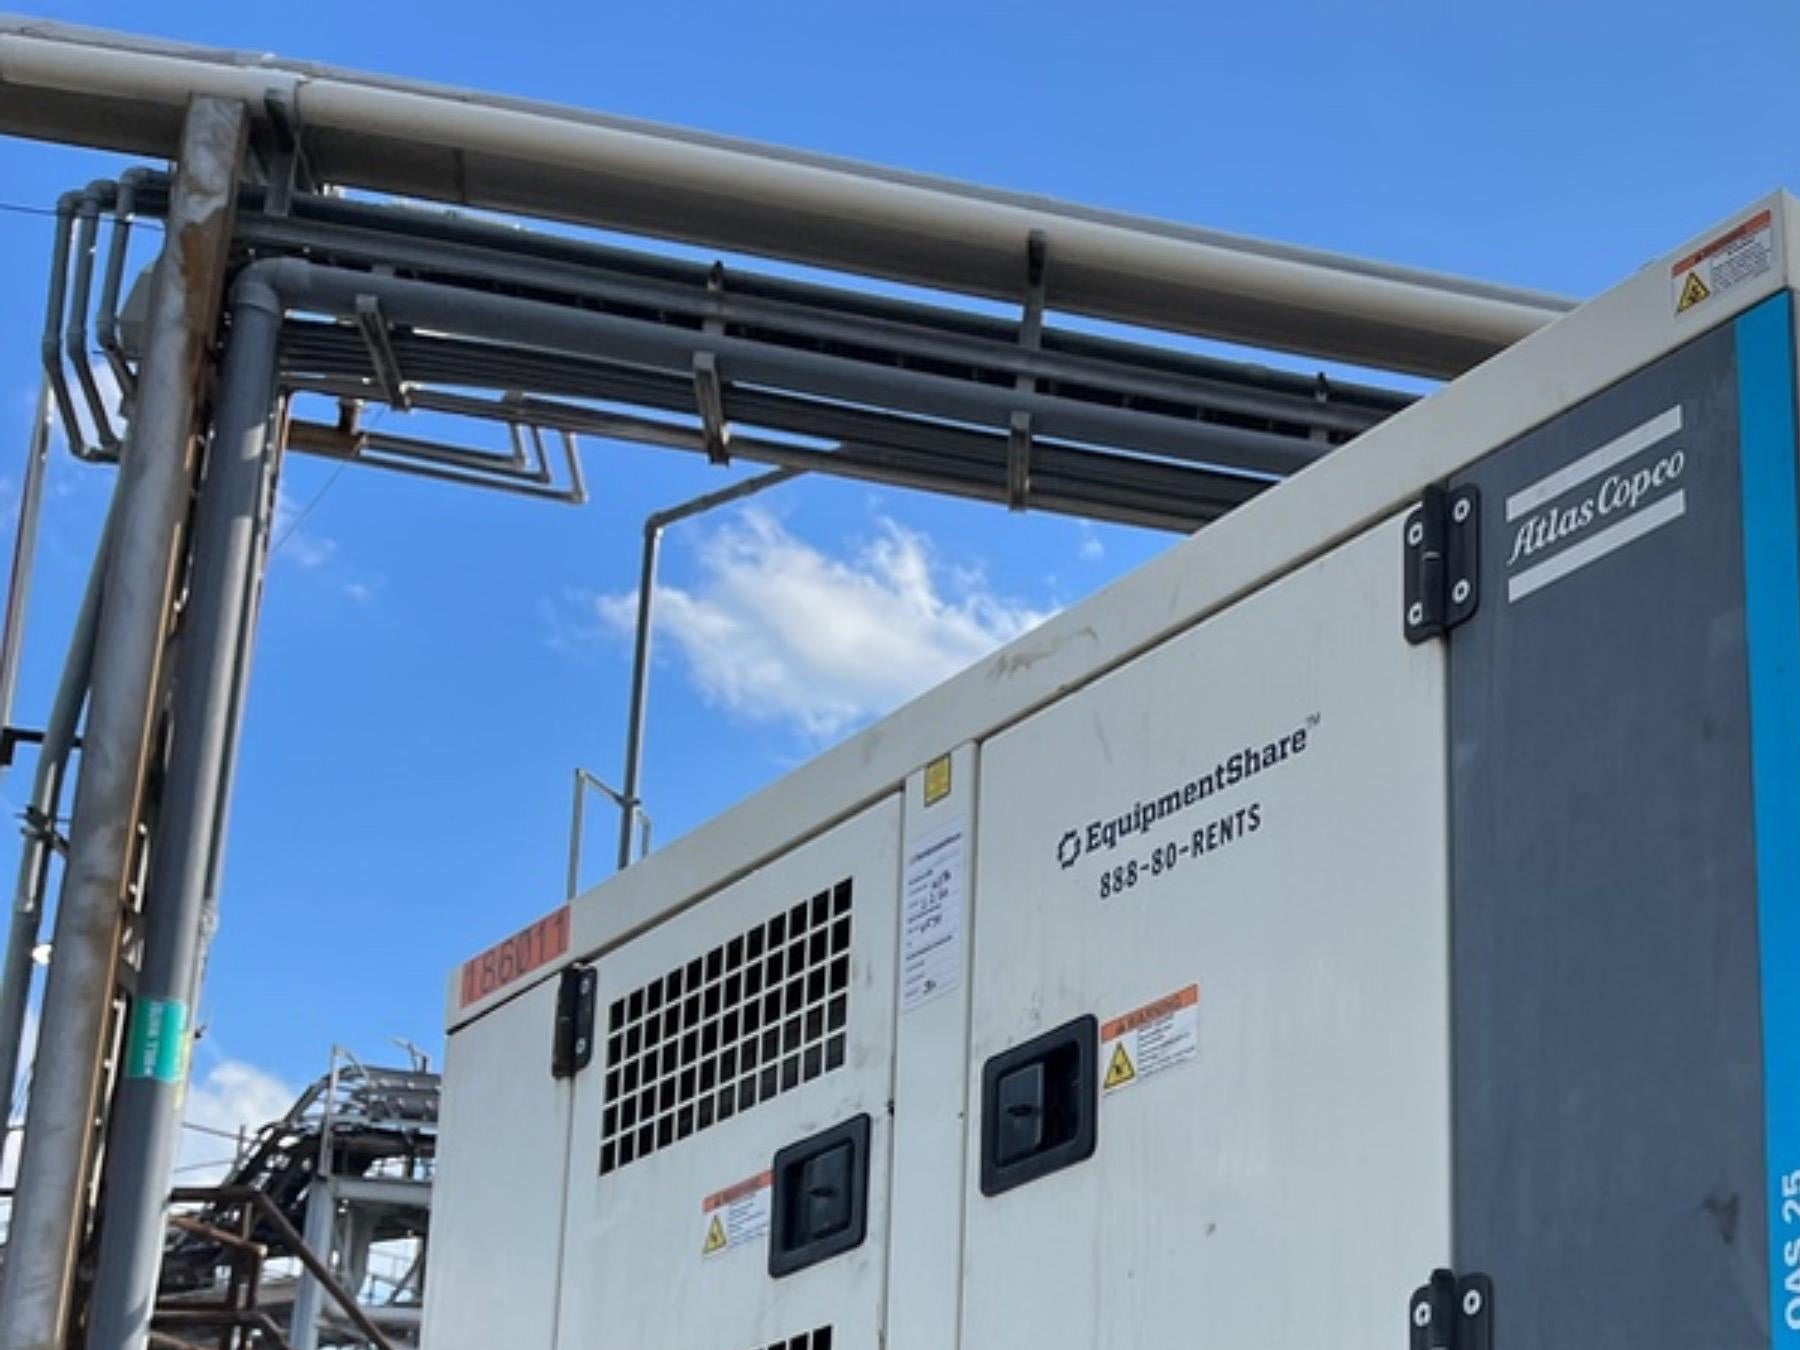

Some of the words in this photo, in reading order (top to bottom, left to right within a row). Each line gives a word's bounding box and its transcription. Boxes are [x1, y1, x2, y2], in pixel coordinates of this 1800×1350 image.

[1506, 499, 1594, 567] Atlas
[1598, 450, 1684, 514] Copco
[1085, 727, 1307, 854] EquipmentShare
[1099, 803, 1261, 900] 888-80-RENTS
